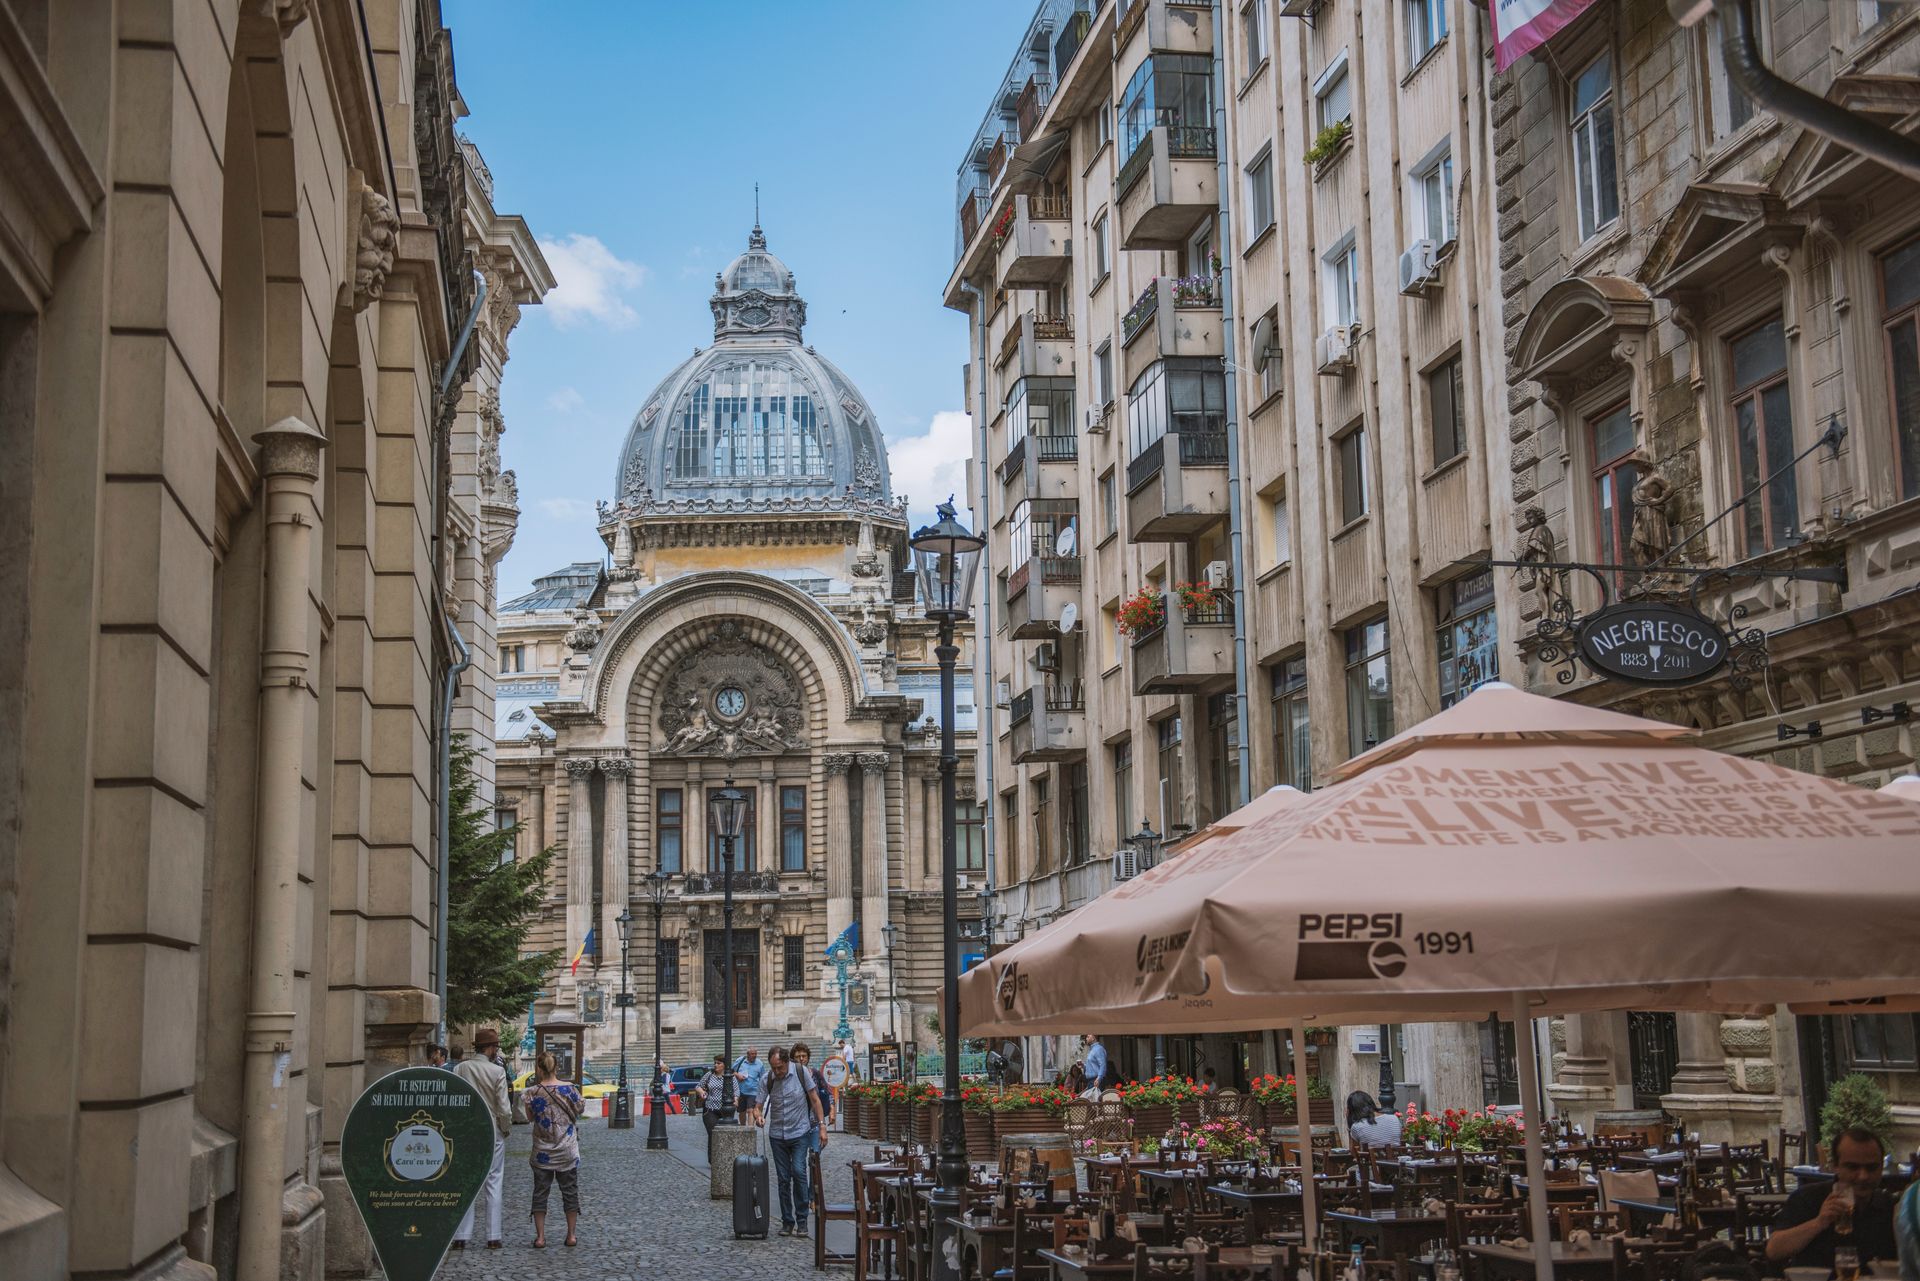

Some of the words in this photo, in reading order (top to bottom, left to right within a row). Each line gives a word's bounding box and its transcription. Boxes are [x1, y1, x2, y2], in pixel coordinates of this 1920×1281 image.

[1591, 619, 1718, 658] NEGRESCO
[1620, 652, 1648, 666] 1883
[1559, 760, 1717, 785] LIVE
[1385, 783, 1416, 796] IS
[1423, 785, 1446, 798] A
[1401, 798, 1623, 832] LIVE
[1654, 797, 1749, 812] LIFE
[1750, 795, 1798, 810] IS
[1806, 793, 1845, 810] A
[1431, 831, 1519, 846] LIFE
[1523, 829, 1568, 844] IS
[1577, 829, 1608, 842] A
[1298, 913, 1403, 940] PEPSI
[1414, 931, 1475, 955] 1991
[399, 1079, 408, 1092] TE
[404, 1094, 414, 1106] LA
[438, 1094, 448, 1106] CU
[449, 1094, 471, 1107] BERE!
[392, 1190, 421, 1200] forward
[429, 1191, 449, 1200] seeing
[449, 1192, 462, 1200] you
[442, 1199, 459, 1207] bere!
